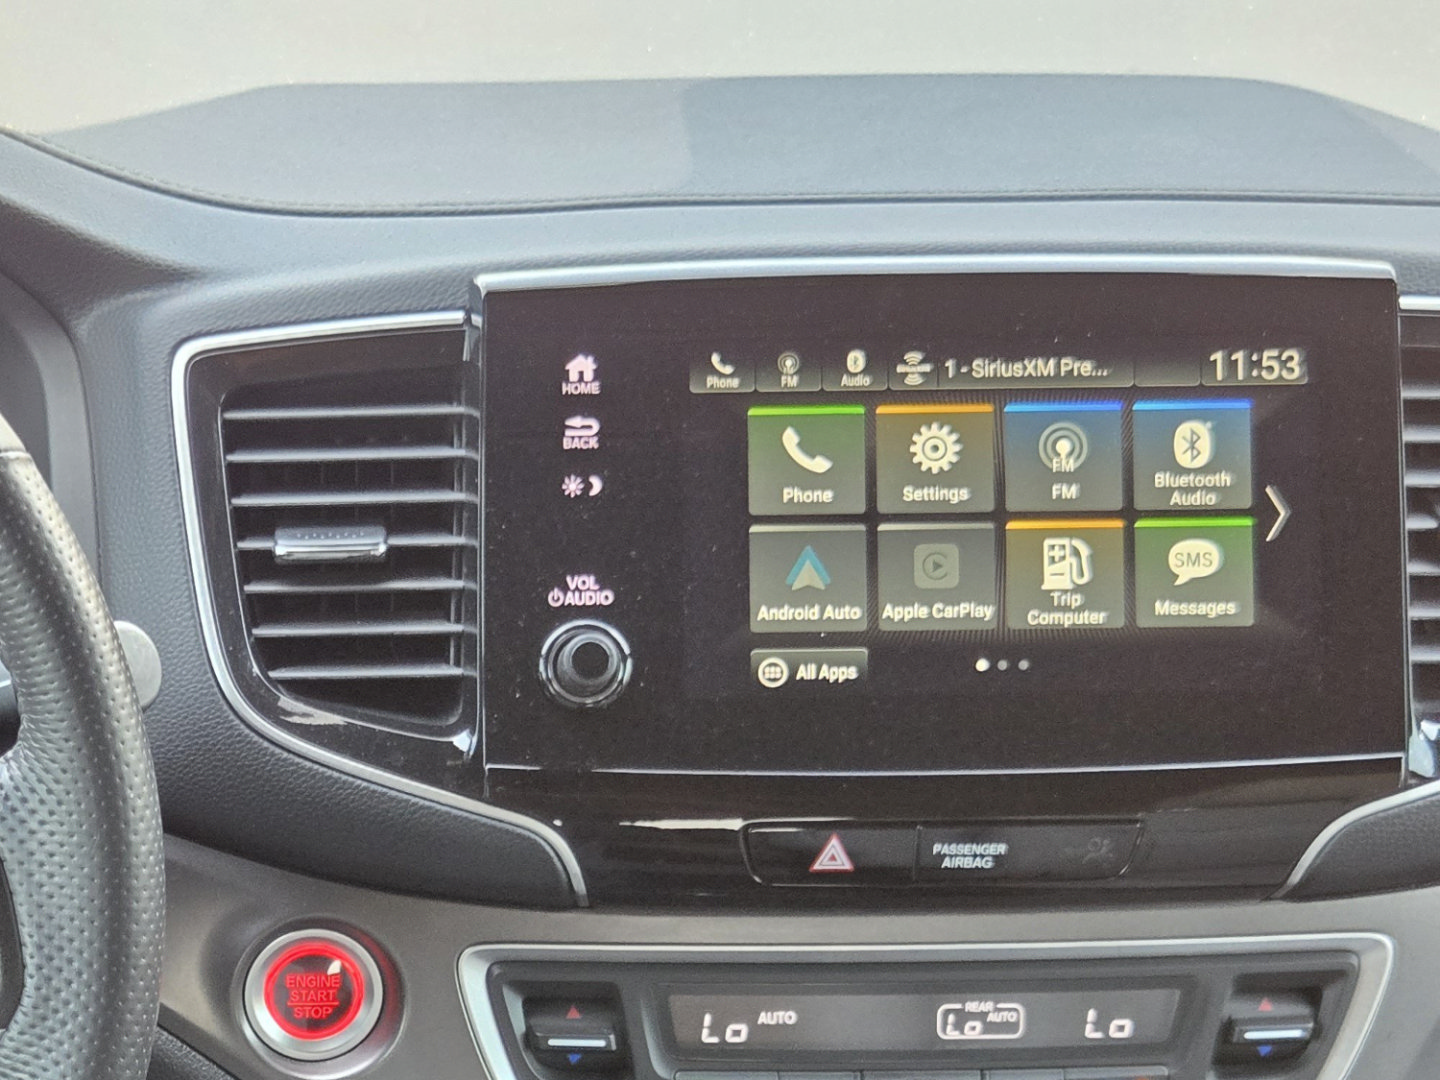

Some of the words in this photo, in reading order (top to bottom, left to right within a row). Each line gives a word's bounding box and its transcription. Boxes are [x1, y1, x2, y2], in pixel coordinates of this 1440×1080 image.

[944, 359, 955, 379] 1
[971, 358, 1055, 378] SiriusXM
[1059, 360, 1108, 378] Pre...
[1209, 350, 1303, 381] 11:53
[706, 375, 742, 389] Phone
[780, 375, 799, 388] FM
[840, 373, 872, 387] Audio
[562, 382, 601, 395] HOME
[562, 437, 600, 449] BACK
[1154, 471, 1232, 489] Bluetooth
[783, 487, 834, 504] Phone
[903, 486, 971, 505] Settings
[1052, 482, 1078, 500] FM
[1170, 490, 1217, 506] Audio
[1174, 550, 1214, 569] SMS
[566, 575, 600, 591] VOL
[564, 590, 615, 606] AUDIO
[1050, 591, 1083, 608] Trip
[757, 603, 820, 621] Android
[822, 604, 862, 621] Auto
[882, 603, 928, 624] Apple
[931, 602, 994, 622] CarPlay
[1154, 600, 1236, 618] Messages
[1027, 609, 1107, 630] Computer
[796, 663, 817, 681] All
[818, 664, 858, 684] Apps
[932, 843, 1008, 856] PASSENGER
[941, 856, 994, 869] AIRBAG
[286, 975, 342, 988] ENGINE
[290, 991, 336, 1002] START
[294, 1006, 333, 1019] STOP
[965, 1001, 995, 1012] REAR
[758, 1010, 798, 1025] AUTO
[986, 1011, 1019, 1022] AUTO
